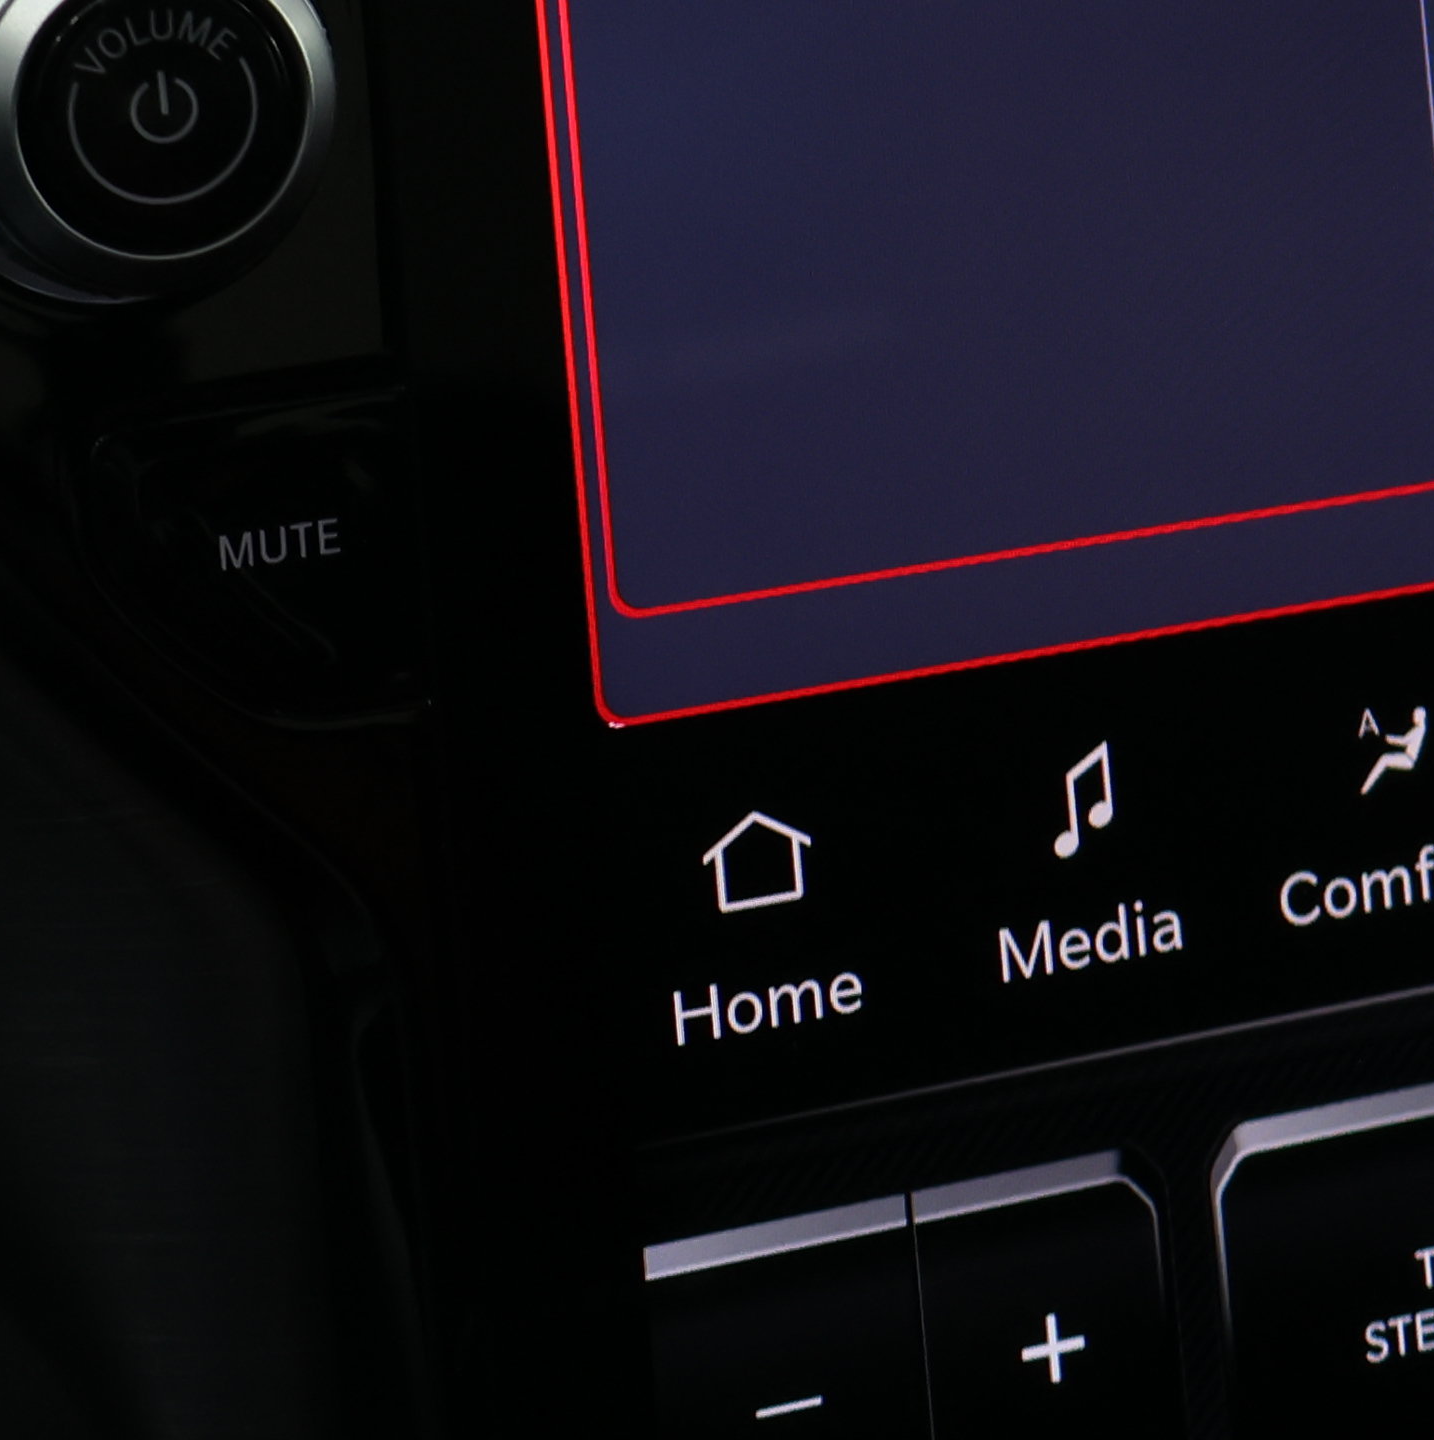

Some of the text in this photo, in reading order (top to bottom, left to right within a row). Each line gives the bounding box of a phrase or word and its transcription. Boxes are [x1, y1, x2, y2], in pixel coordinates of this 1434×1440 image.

[74, 9, 240, 78] VOLUME
[218, 517, 341, 571] MUTE
[998, 899, 1183, 983] Media
[673, 972, 863, 1047] Home
